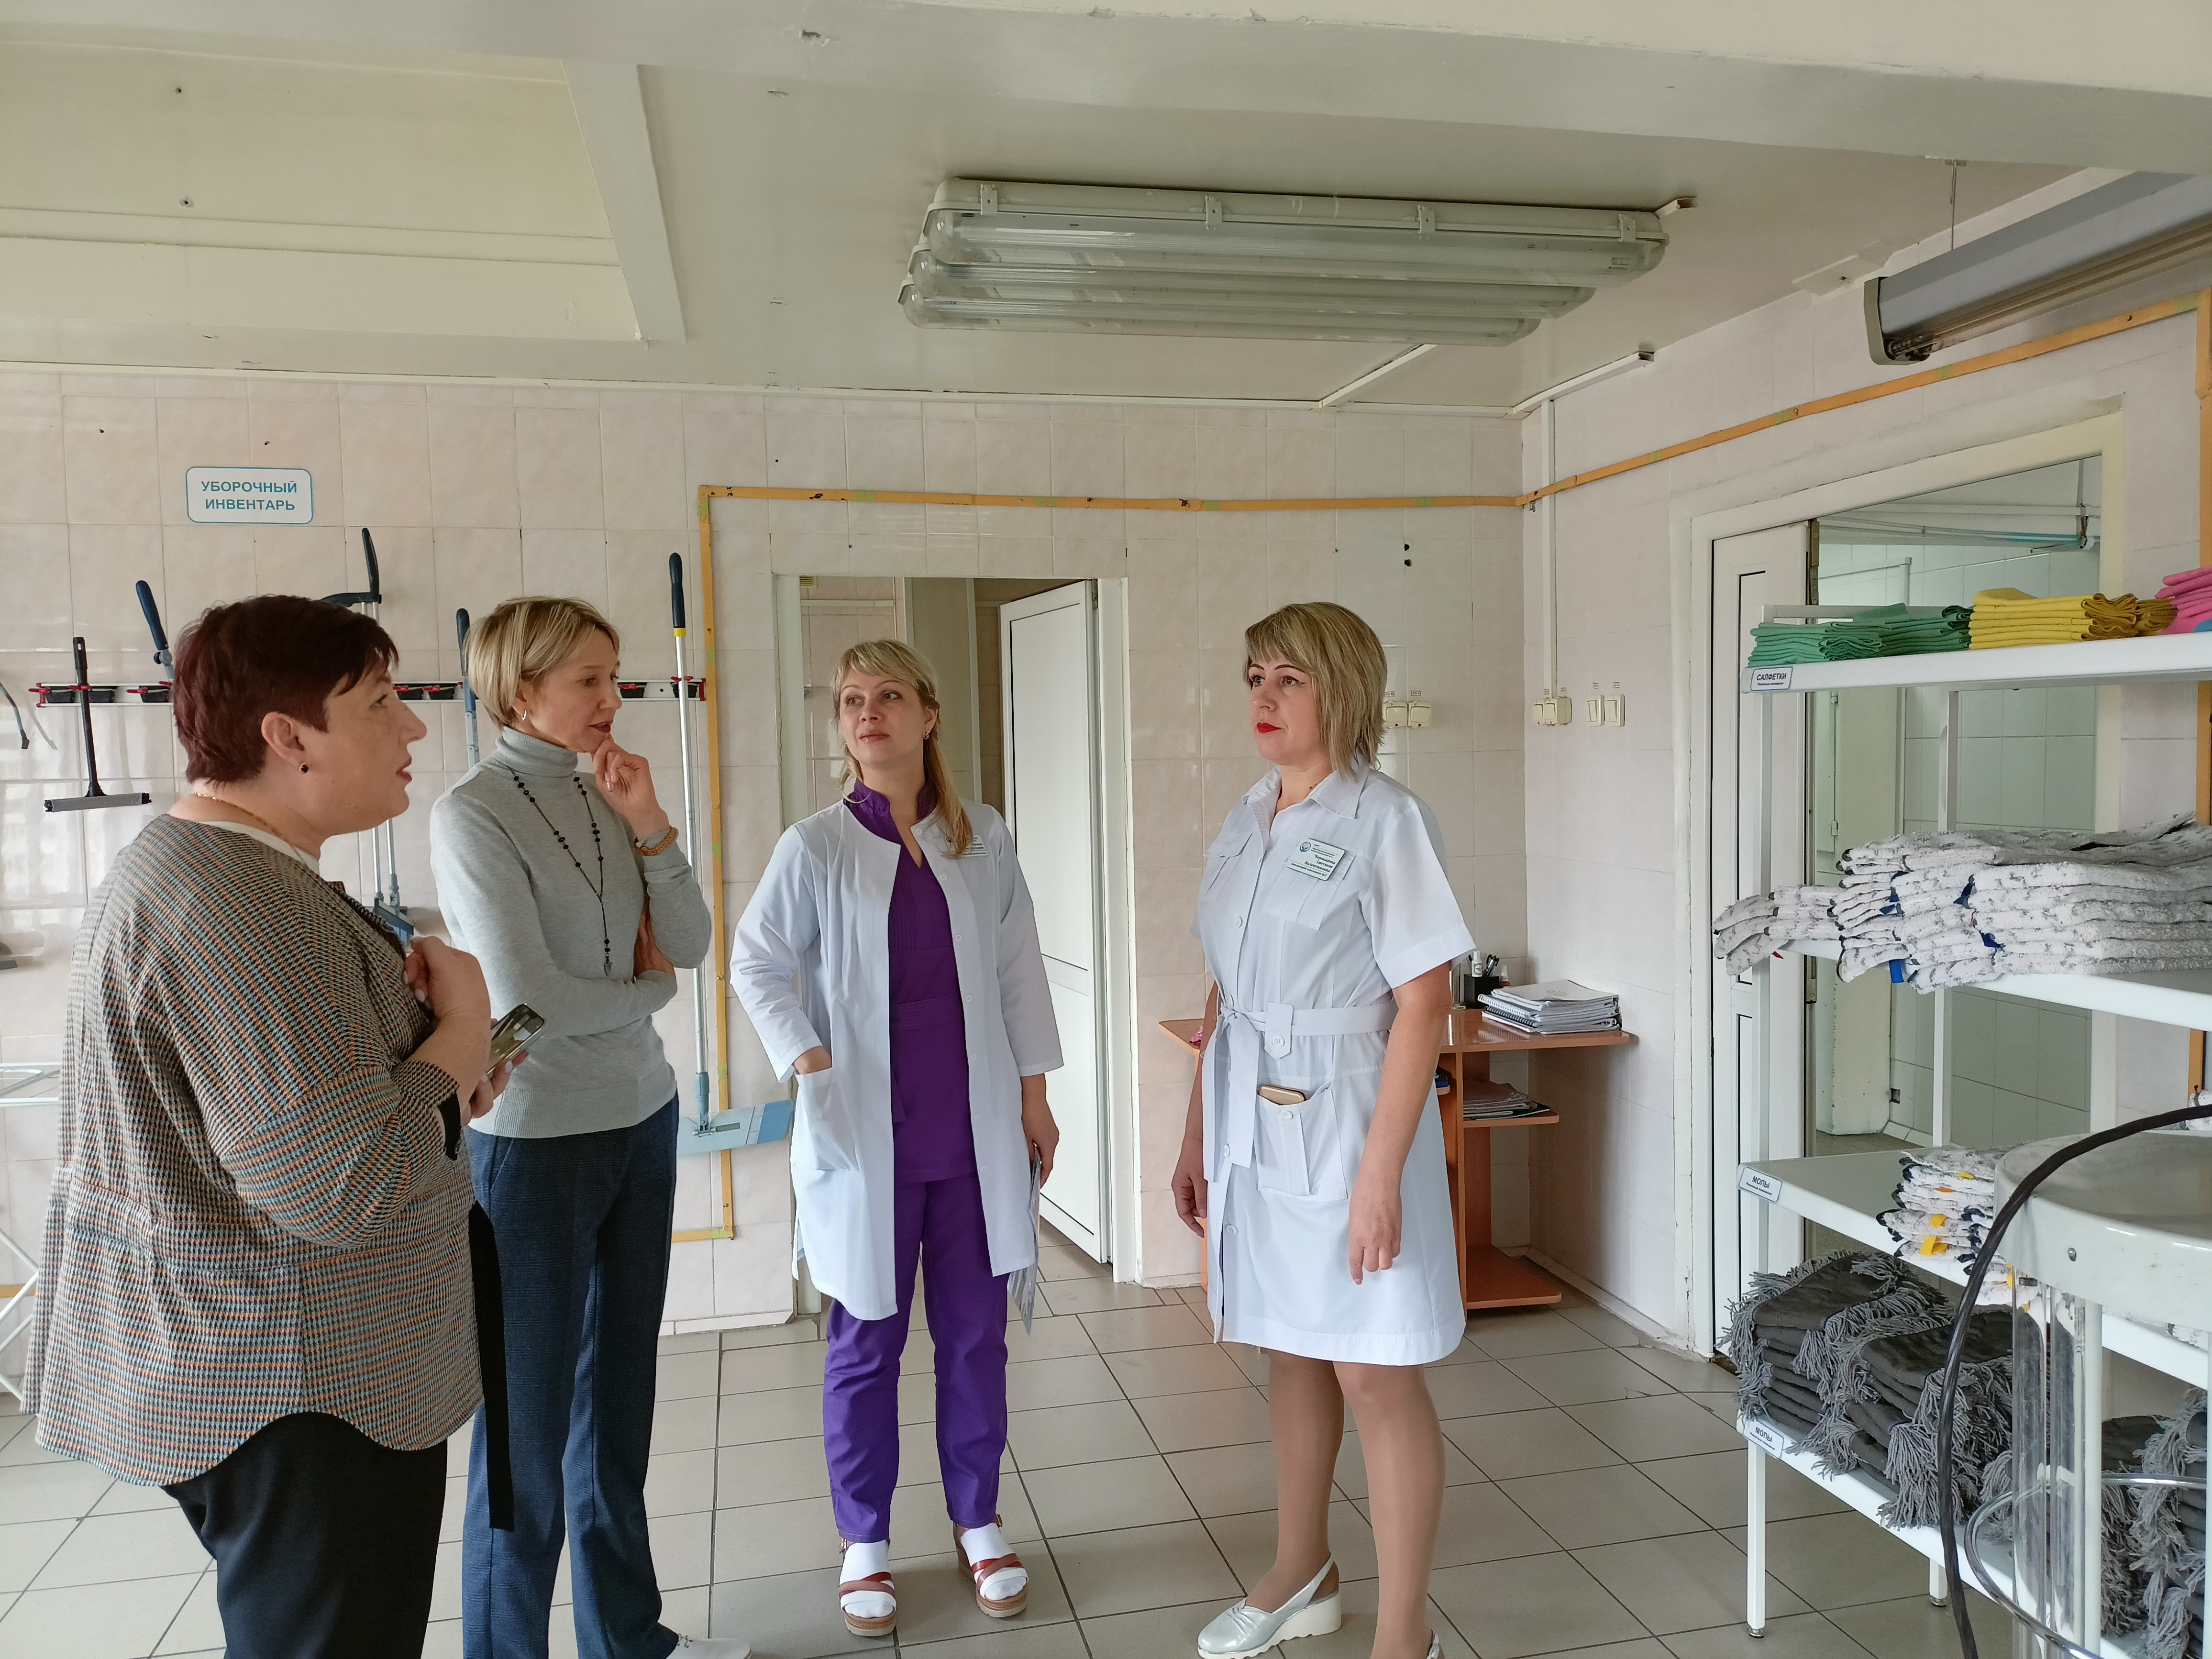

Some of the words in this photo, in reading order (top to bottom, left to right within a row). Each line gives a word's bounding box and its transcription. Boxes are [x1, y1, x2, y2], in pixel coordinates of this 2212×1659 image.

[201, 480, 297, 493] УБОРОЧНЫЙ
[205, 499, 295, 510] ИНВЕНТАРЬ
[1757, 673, 1787, 681] САЛФЕТКИ
[1752, 1176, 1770, 1189] МОПЫ
[1755, 1427, 1772, 1443] МОПЫ
